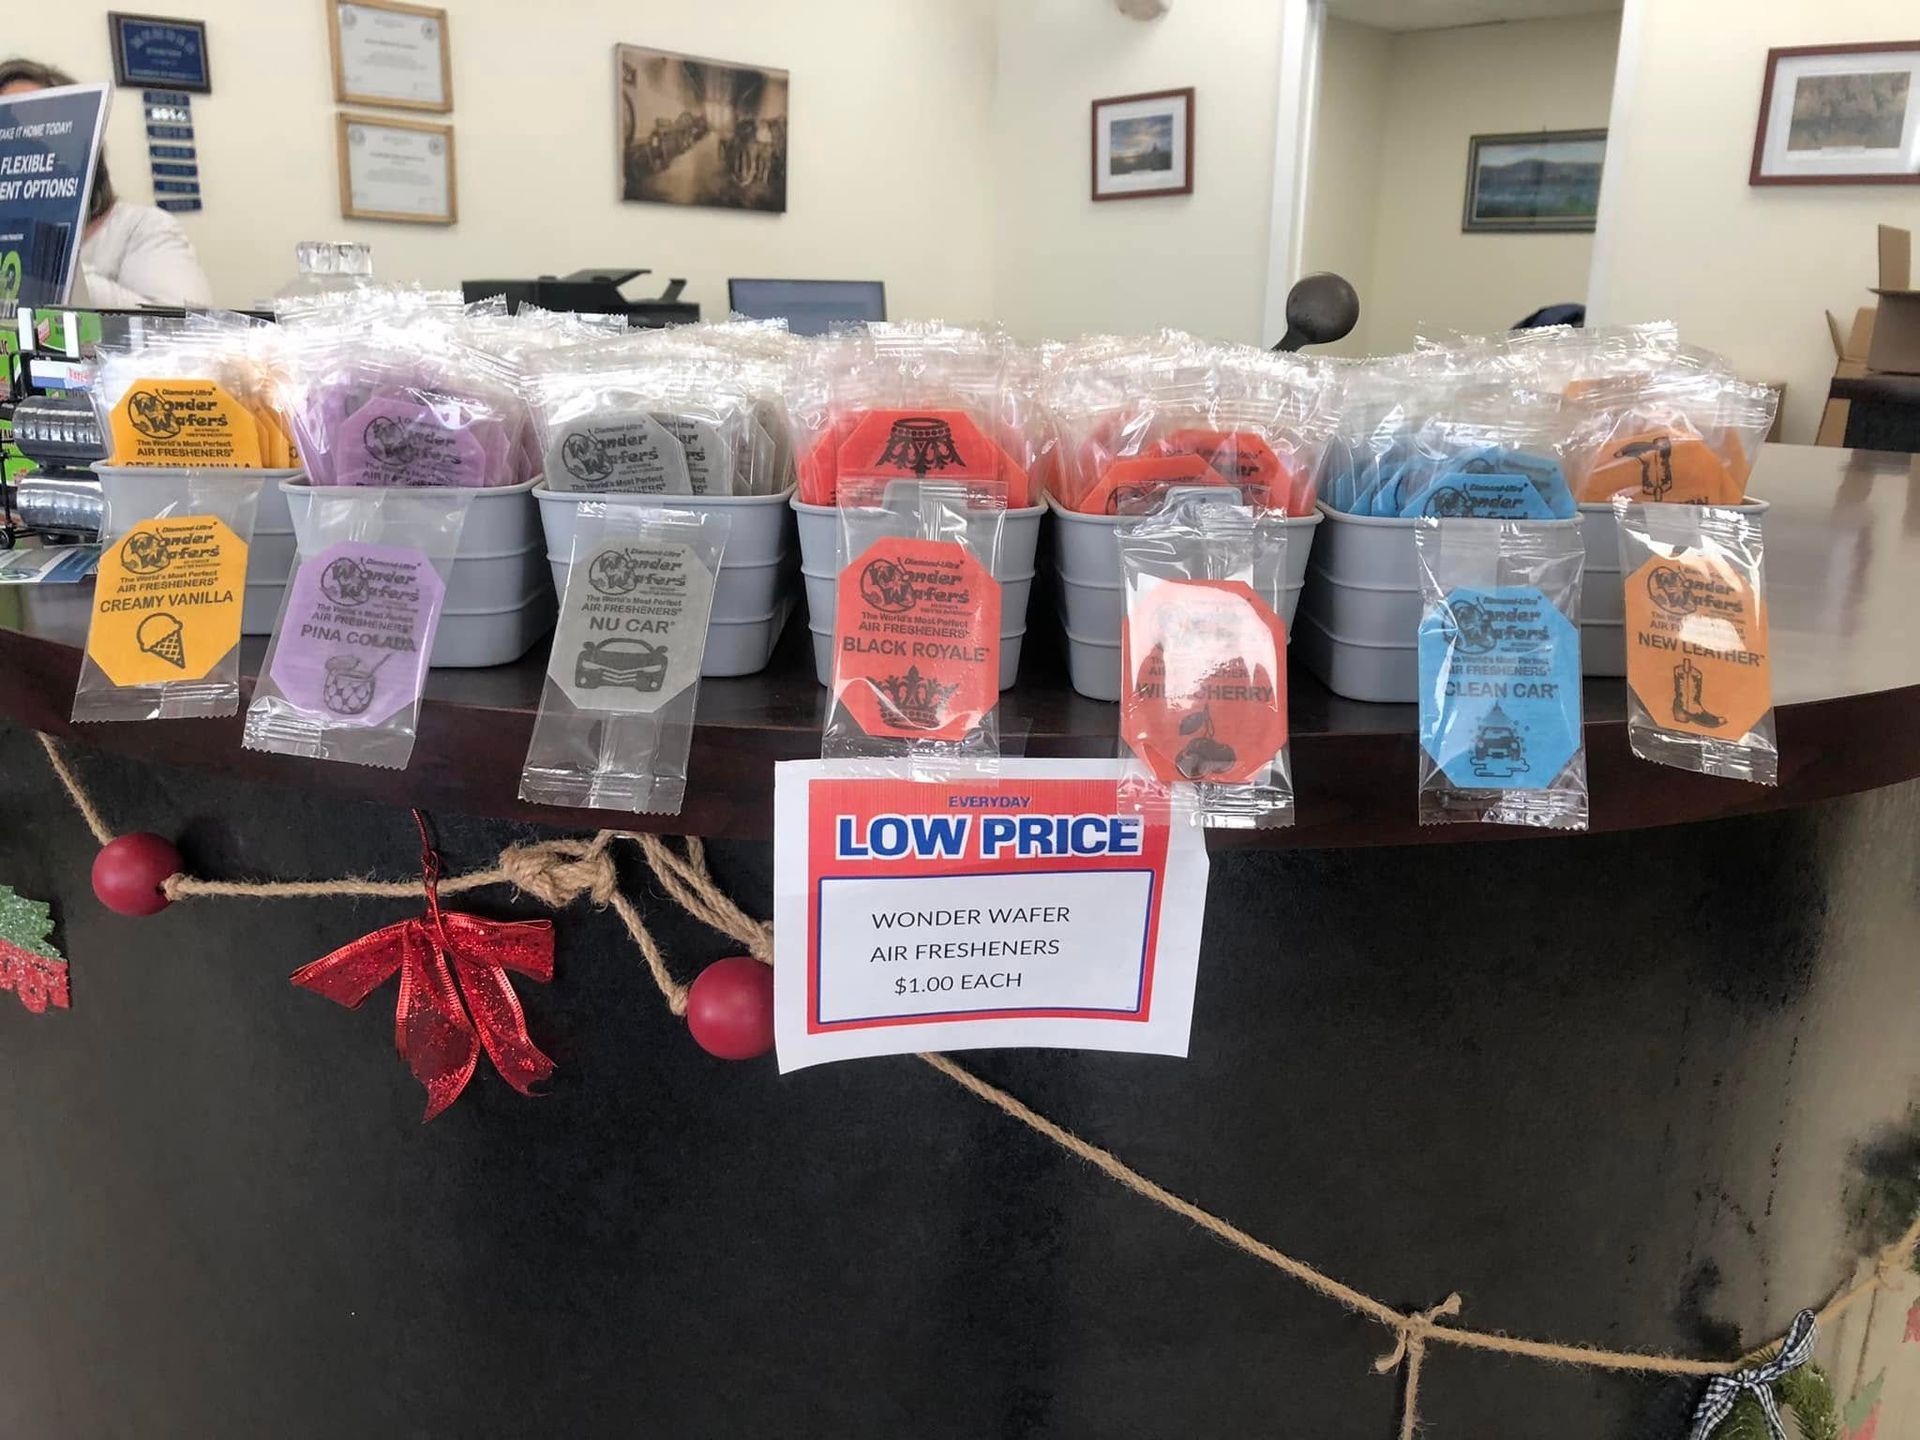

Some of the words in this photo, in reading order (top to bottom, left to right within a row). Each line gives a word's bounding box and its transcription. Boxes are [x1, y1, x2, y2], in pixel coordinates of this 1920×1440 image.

[22, 123, 45, 138] HOME
[0, 153, 55, 175] FLEXIBLE
[23, 177, 79, 199] OPTIONS!
[137, 448, 156, 457] AIR
[157, 448, 232, 457] FRESHENERS
[117, 584, 136, 593] AIR
[140, 577, 214, 591] FRESHENERS
[100, 595, 165, 613] CREAMY
[168, 590, 233, 607] VANILLA
[581, 603, 601, 611] AIR
[603, 604, 678, 616] FRESHENERS
[312, 612, 331, 621] AIR
[590, 616, 620, 631] NU
[625, 618, 668, 634] CAR
[301, 624, 341, 642] PINA
[346, 631, 417, 652] COLADA
[859, 622, 881, 632] AIR
[883, 624, 965, 638] FRESHENERS
[843, 636, 907, 656] BLACK
[912, 642, 986, 662] ROYALE
[1638, 632, 1677, 651] NEW
[1193, 684, 1273, 702] CHERRY
[1445, 681, 1508, 698] CLEAN
[1513, 683, 1554, 699] CAR
[948, 796, 1031, 808] EVERYDAY
[837, 816, 969, 858] LOW
[981, 816, 1140, 855] PRICE
[871, 908, 981, 929] WONDER
[988, 906, 1071, 925] WAFER
[870, 944, 908, 963] AIR
[915, 938, 1060, 960] FRESHENERS
[894, 976, 953, 997] $1.00
[961, 973, 1022, 990] EACH
